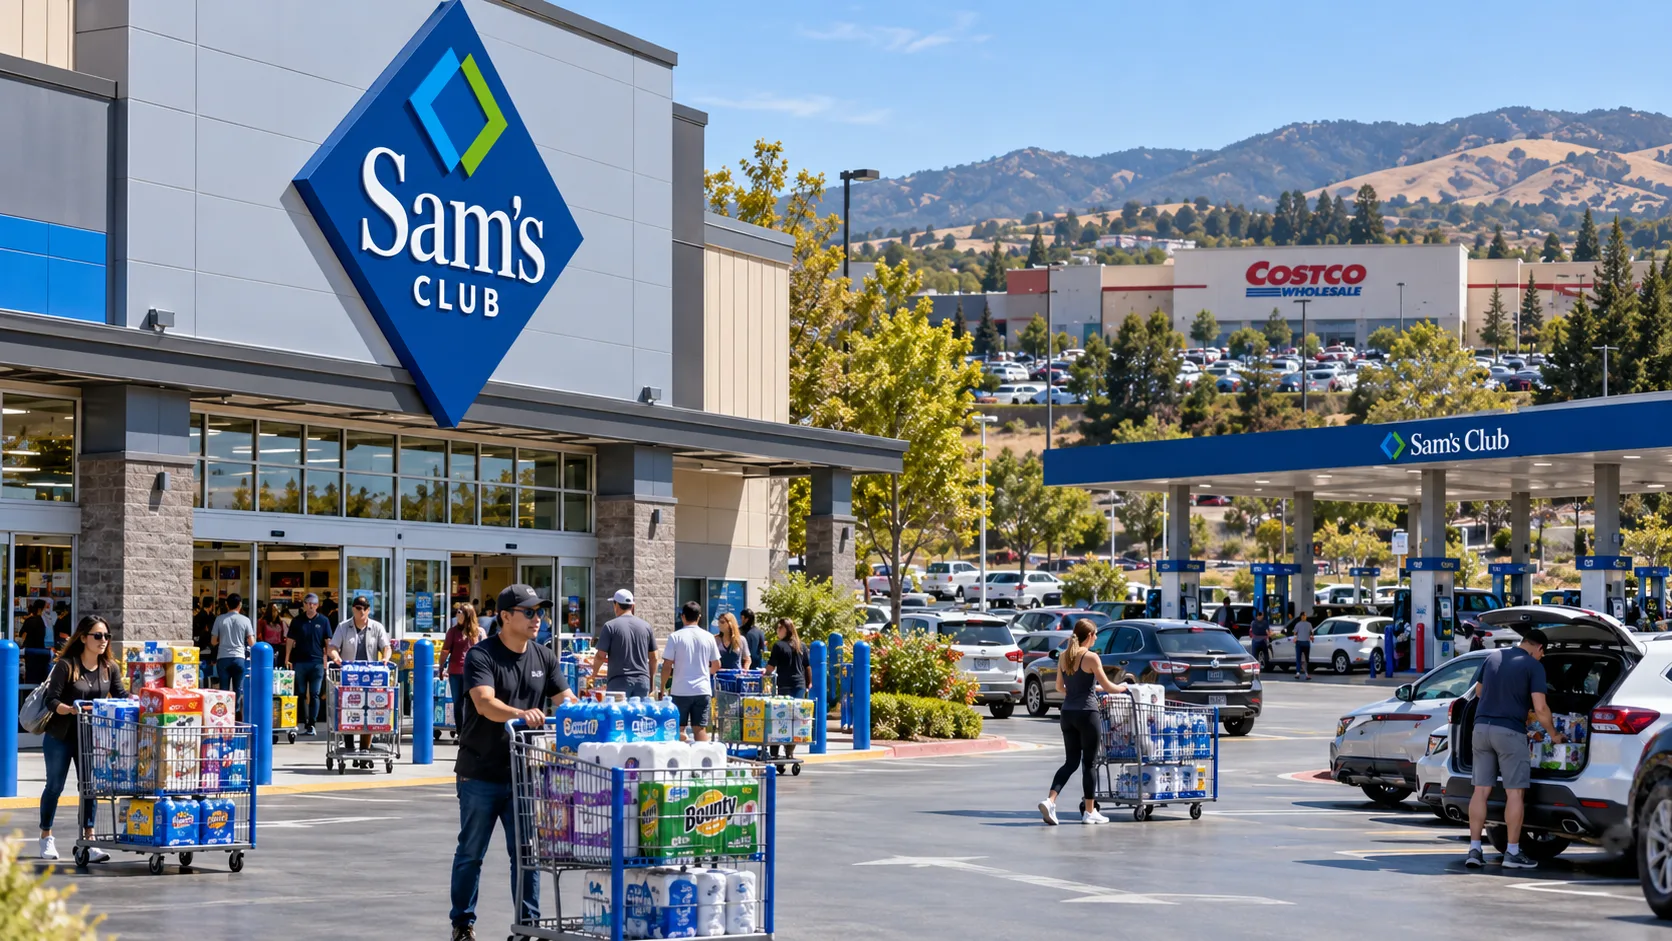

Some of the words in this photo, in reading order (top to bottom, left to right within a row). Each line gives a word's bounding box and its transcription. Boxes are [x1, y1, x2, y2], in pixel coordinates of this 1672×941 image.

[360, 146, 546, 284] Sam's
[1245, 260, 1367, 286] COSTCO
[413, 275, 500, 318] CLUB
[1281, 285, 1363, 298] WHOLESALE
[1410, 432, 1461, 456] Sam's
[1464, 427, 1510, 452] Club
[684, 795, 739, 833] Bounty
